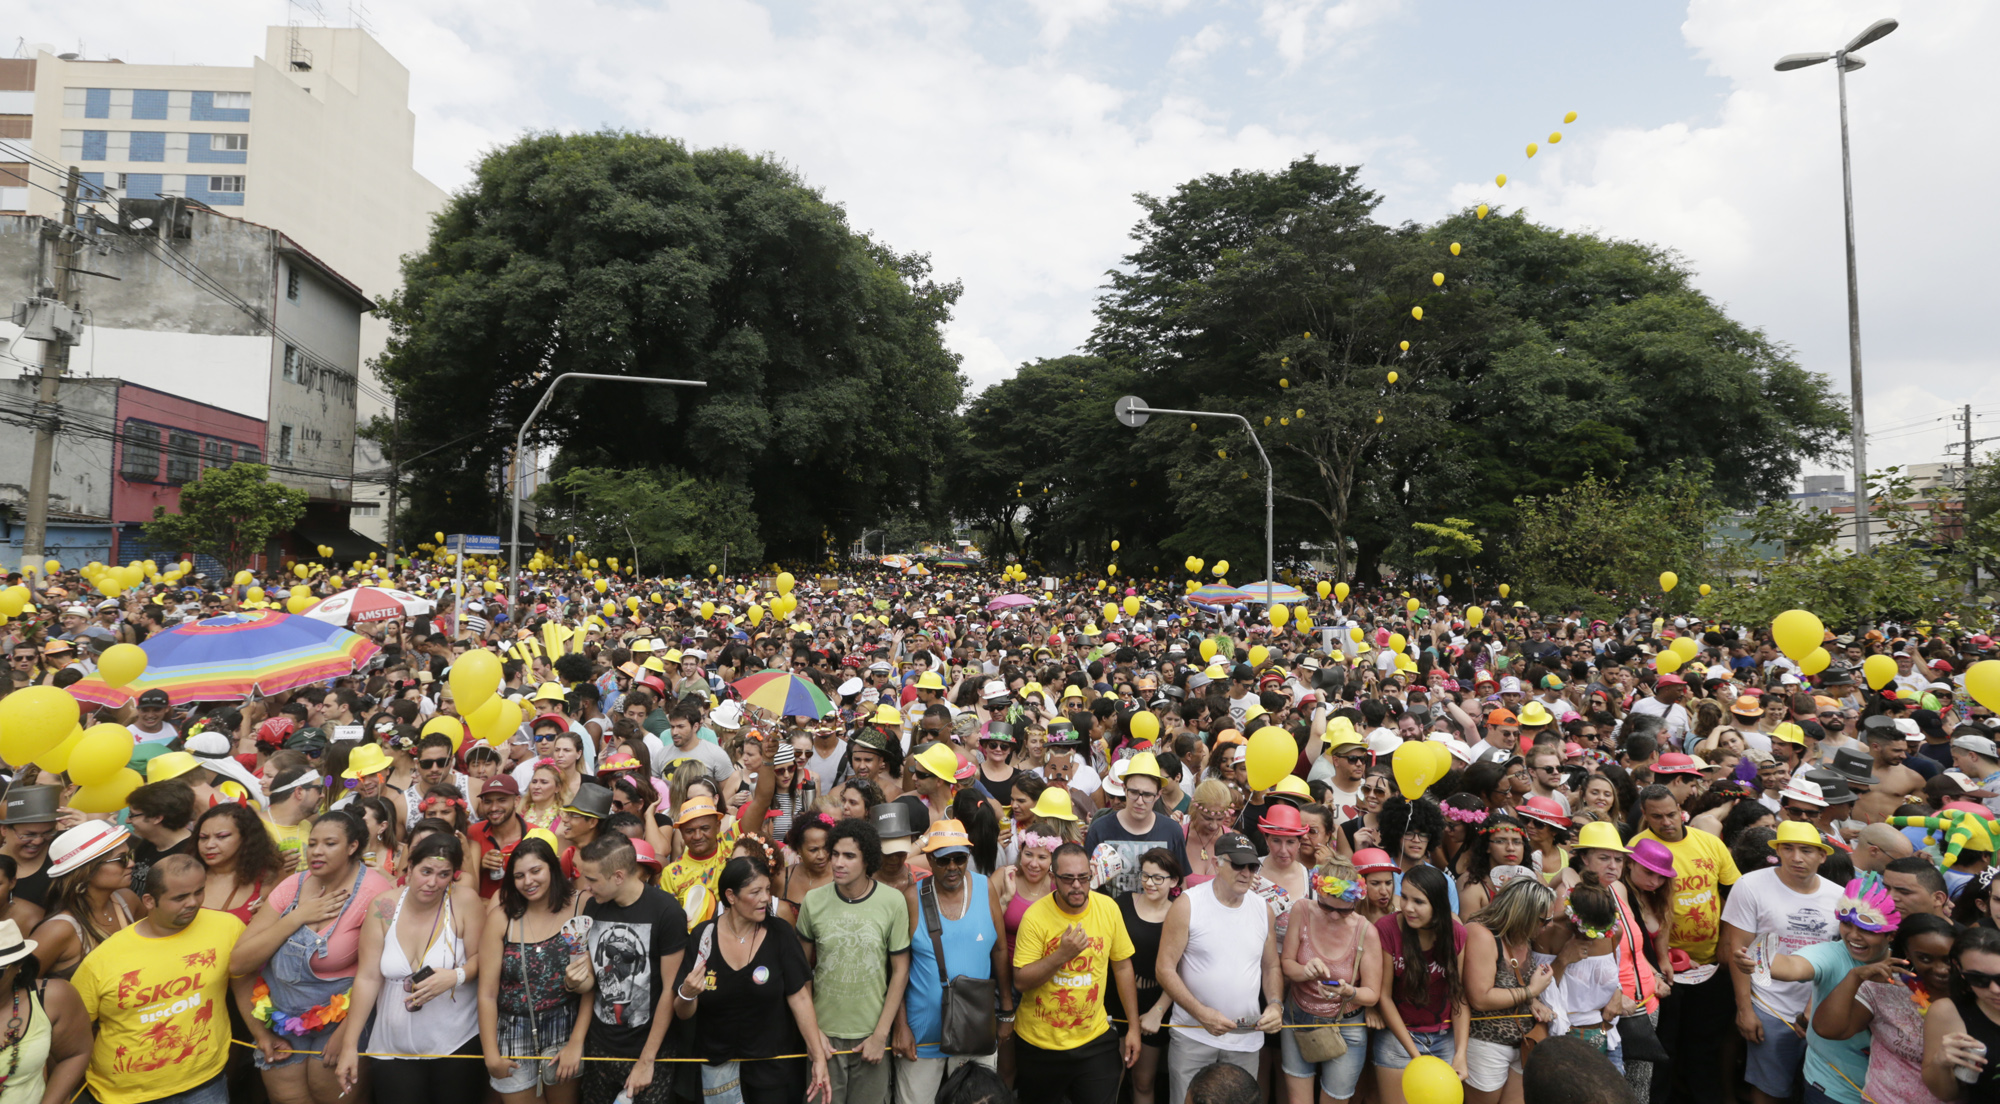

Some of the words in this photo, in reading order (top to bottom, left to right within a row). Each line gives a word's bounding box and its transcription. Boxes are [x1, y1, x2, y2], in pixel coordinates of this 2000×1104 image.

[466, 535, 479, 543] Leão
[357, 607, 399, 621] AMSTEL
[879, 812, 897, 821] AMSTEL
[1674, 873, 1712, 893] SKOL
[133, 972, 206, 1009] SKOL
